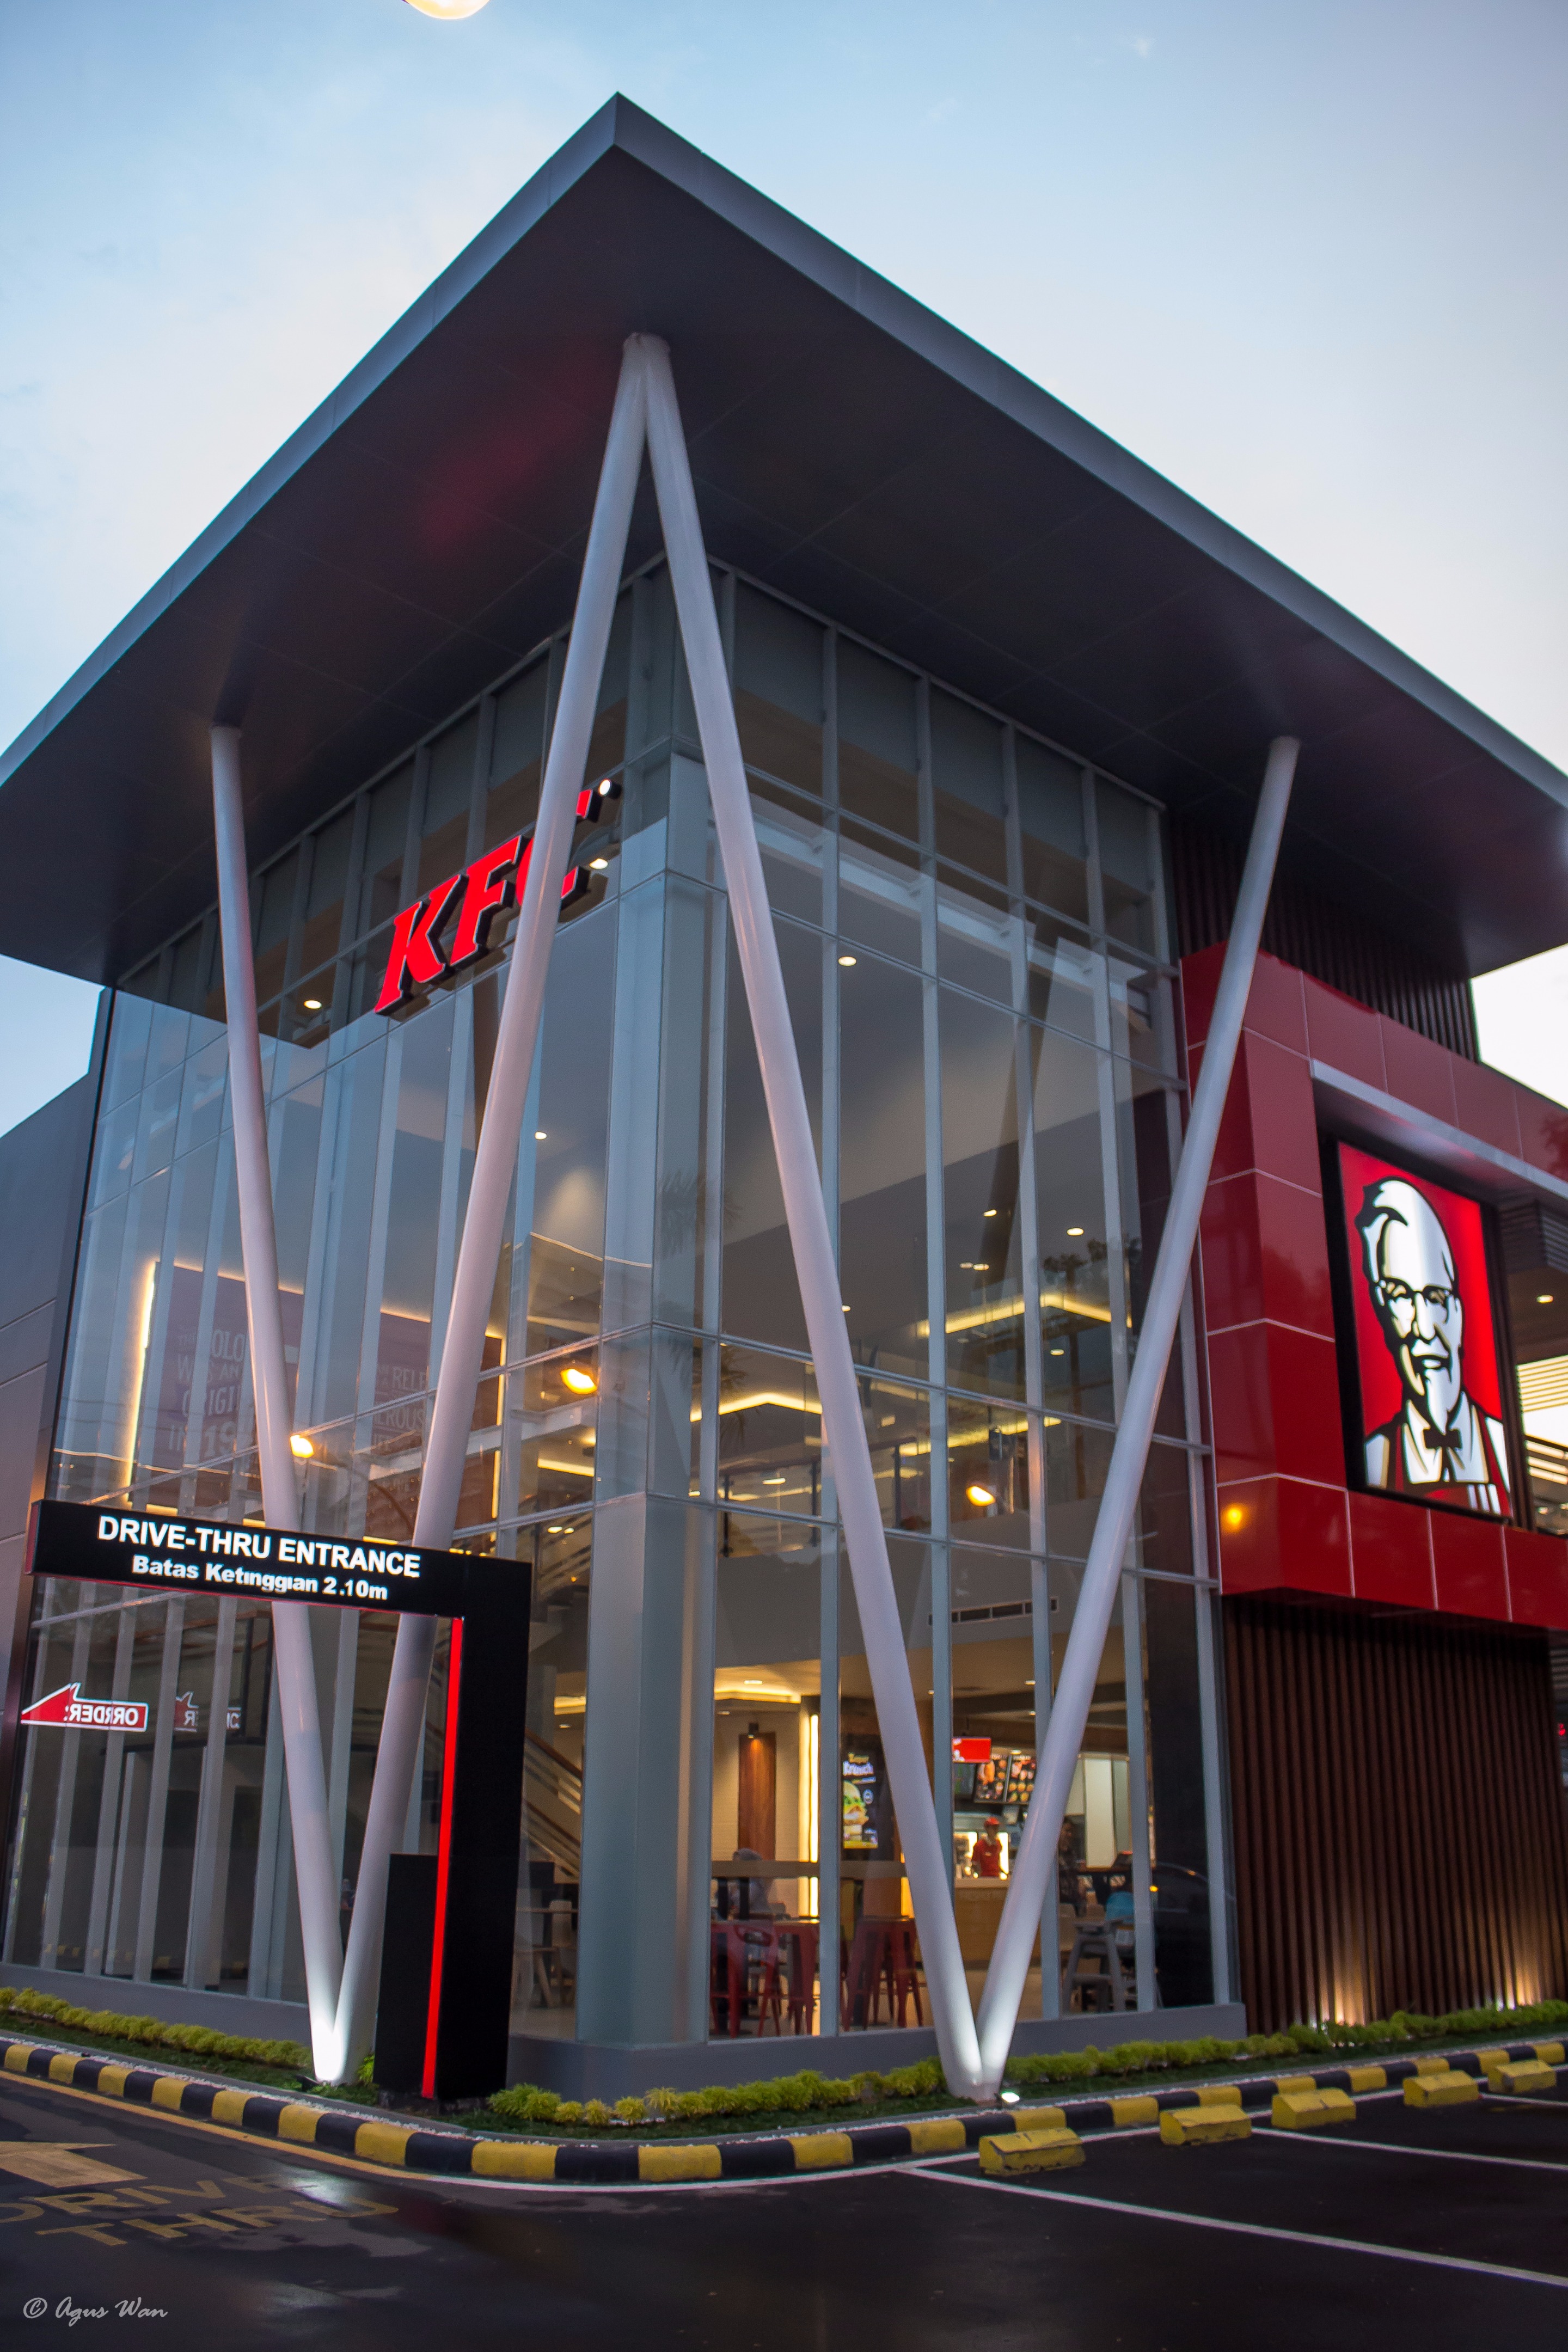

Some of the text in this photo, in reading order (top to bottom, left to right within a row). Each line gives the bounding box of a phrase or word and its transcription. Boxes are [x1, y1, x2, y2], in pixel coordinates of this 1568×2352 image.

[97, 1515, 421, 1578] DRIVE-THRU ENTRANCE
[131, 1554, 199, 1579] Batas
[322, 1576, 388, 1600] 2.10m
[34, 2195, 399, 2246] THRU
